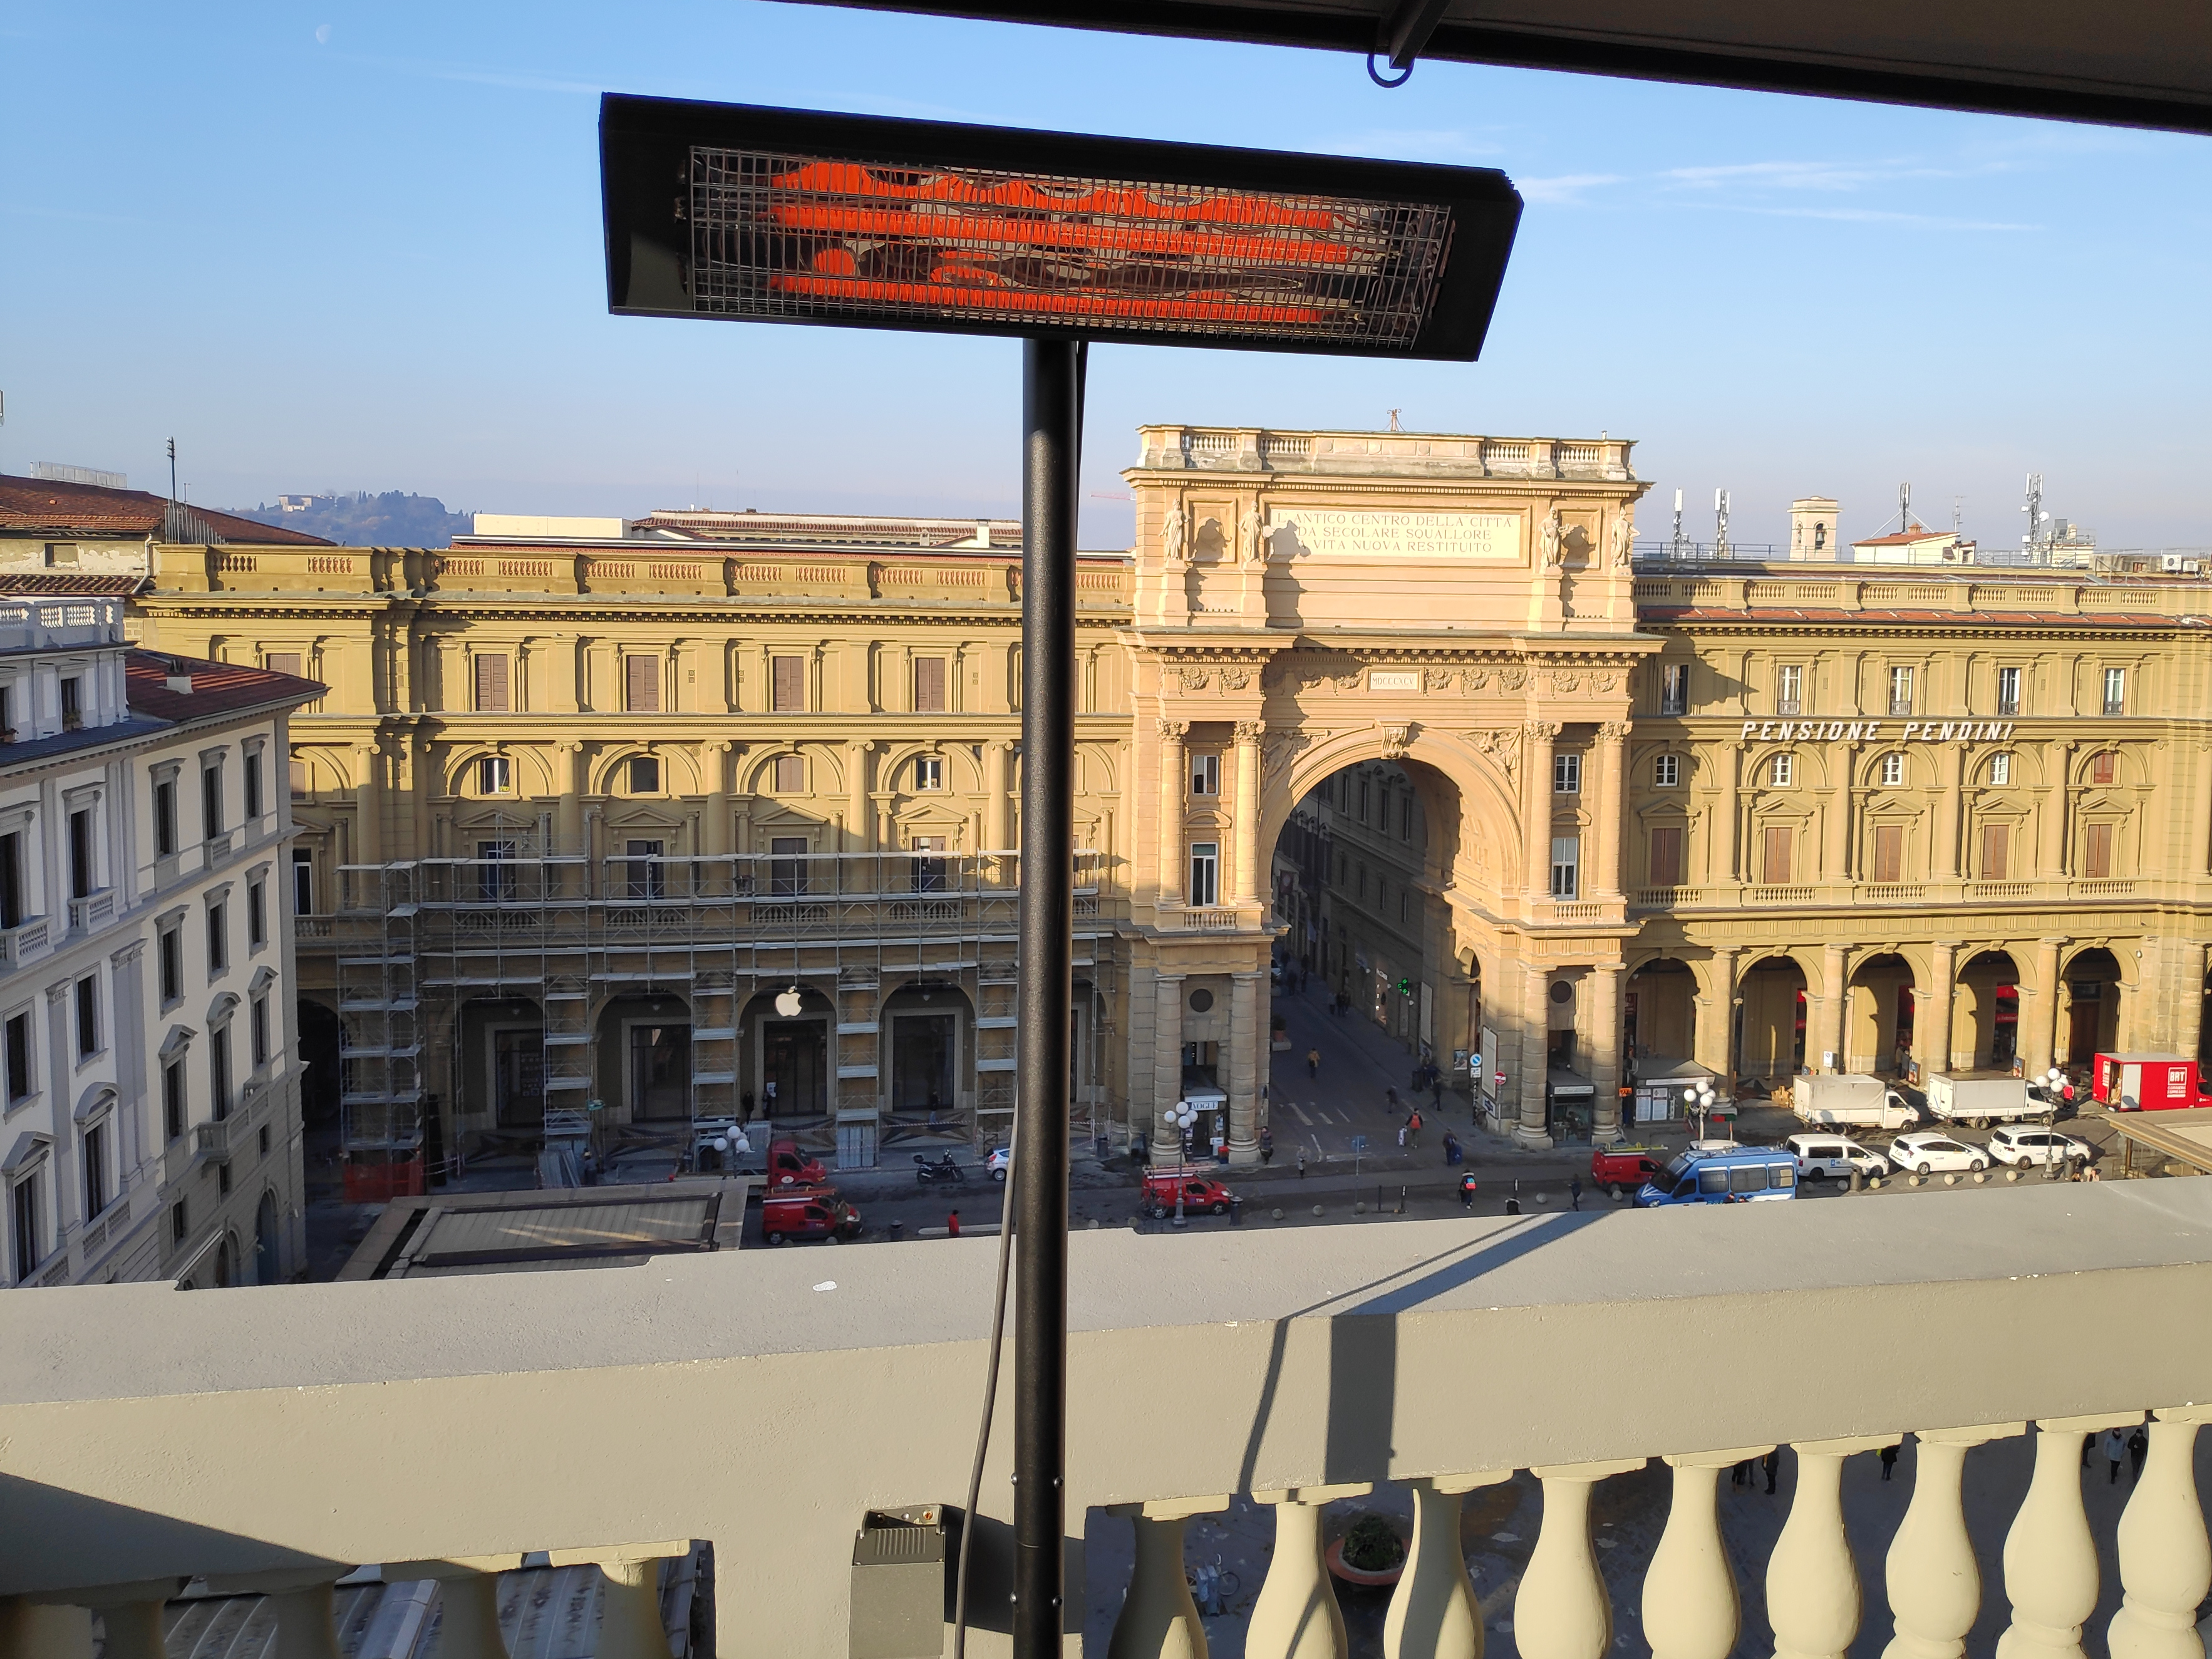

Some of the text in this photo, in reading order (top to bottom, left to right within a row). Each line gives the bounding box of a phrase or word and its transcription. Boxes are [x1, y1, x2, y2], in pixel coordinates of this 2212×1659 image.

[1351, 515, 1410, 525] CENTRO
[1416, 515, 1464, 527] DELLA
[1298, 527, 1492, 540] DA SECOLARE SQUALLORE
[1313, 539, 1346, 550] VITA
[1353, 540, 1401, 551] NUOVA
[1407, 542, 1492, 552] RESTITUITO
[1372, 677, 1414, 685] MDCCCXCV
[1740, 721, 2015, 741] PENSIONE PENDINI
